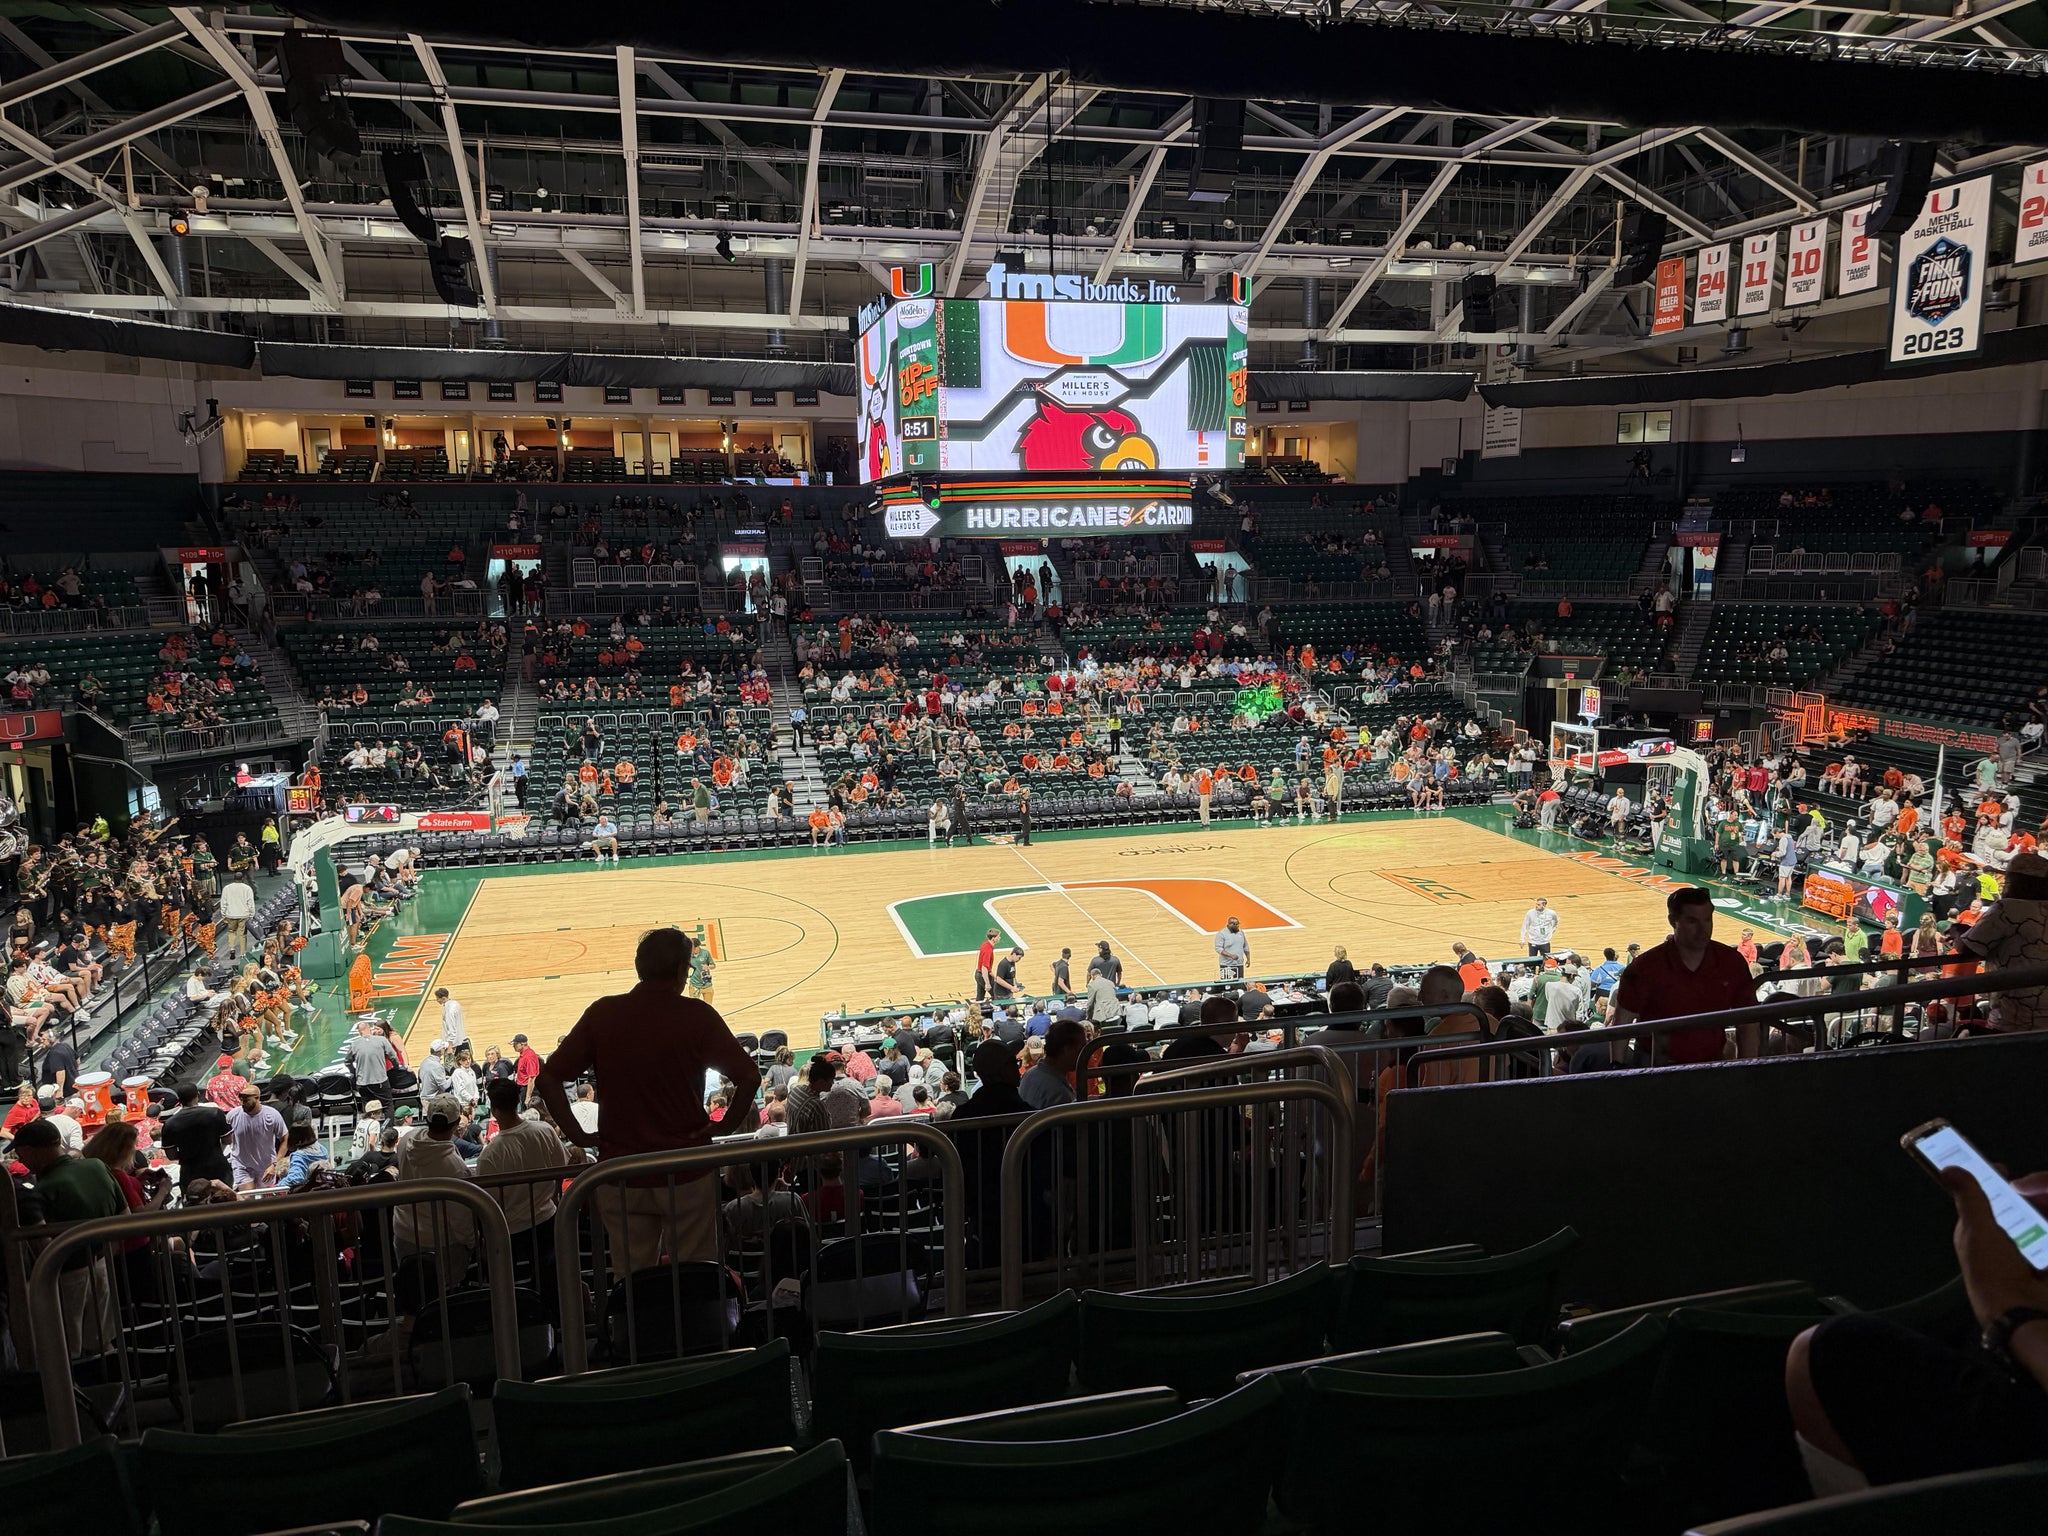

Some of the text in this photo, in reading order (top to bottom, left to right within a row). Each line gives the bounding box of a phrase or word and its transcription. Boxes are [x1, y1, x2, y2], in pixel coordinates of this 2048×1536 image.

[1931, 188, 1960, 213] U
[1914, 217, 1974, 239] BASKETBALL
[1929, 212, 1959, 226] MEN'S
[1800, 226, 1816, 242] U
[2028, 237, 2048, 247] BARR
[2032, 230, 2048, 239] RIC
[1707, 251, 1721, 265] U
[1751, 240, 1768, 254] U
[1851, 235, 1869, 263] 2
[1744, 260, 1768, 288] 11
[1791, 248, 1820, 277] 10
[1919, 256, 1961, 284] FINAL
[891, 263, 933, 299] U
[985, 262, 1180, 303] fms bonds, Inc.
[1232, 272, 1252, 306] U
[1698, 271, 1725, 298] 24
[1920, 276, 1963, 302] FOUR
[900, 338, 931, 359] COUNTDOWN
[1903, 327, 1964, 355] 2023
[909, 353, 917, 363] TO
[899, 362, 933, 390] TIP-
[1062, 381, 1109, 390] MILLER'S
[901, 375, 938, 407] OFF
[904, 421, 929, 437] 8:51
[890, 510, 920, 521] MILLER'S
[966, 505, 1131, 529] HURRICANES
[1885, 719, 1999, 753] HURRICANE
[291, 799, 306, 809] 30
[433, 819, 452, 827] State
[1391, 873, 1477, 901] ACC
[368, 933, 452, 998] MIAMI
[83, 1090, 97, 1103] G
[128, 1091, 137, 1100] G
